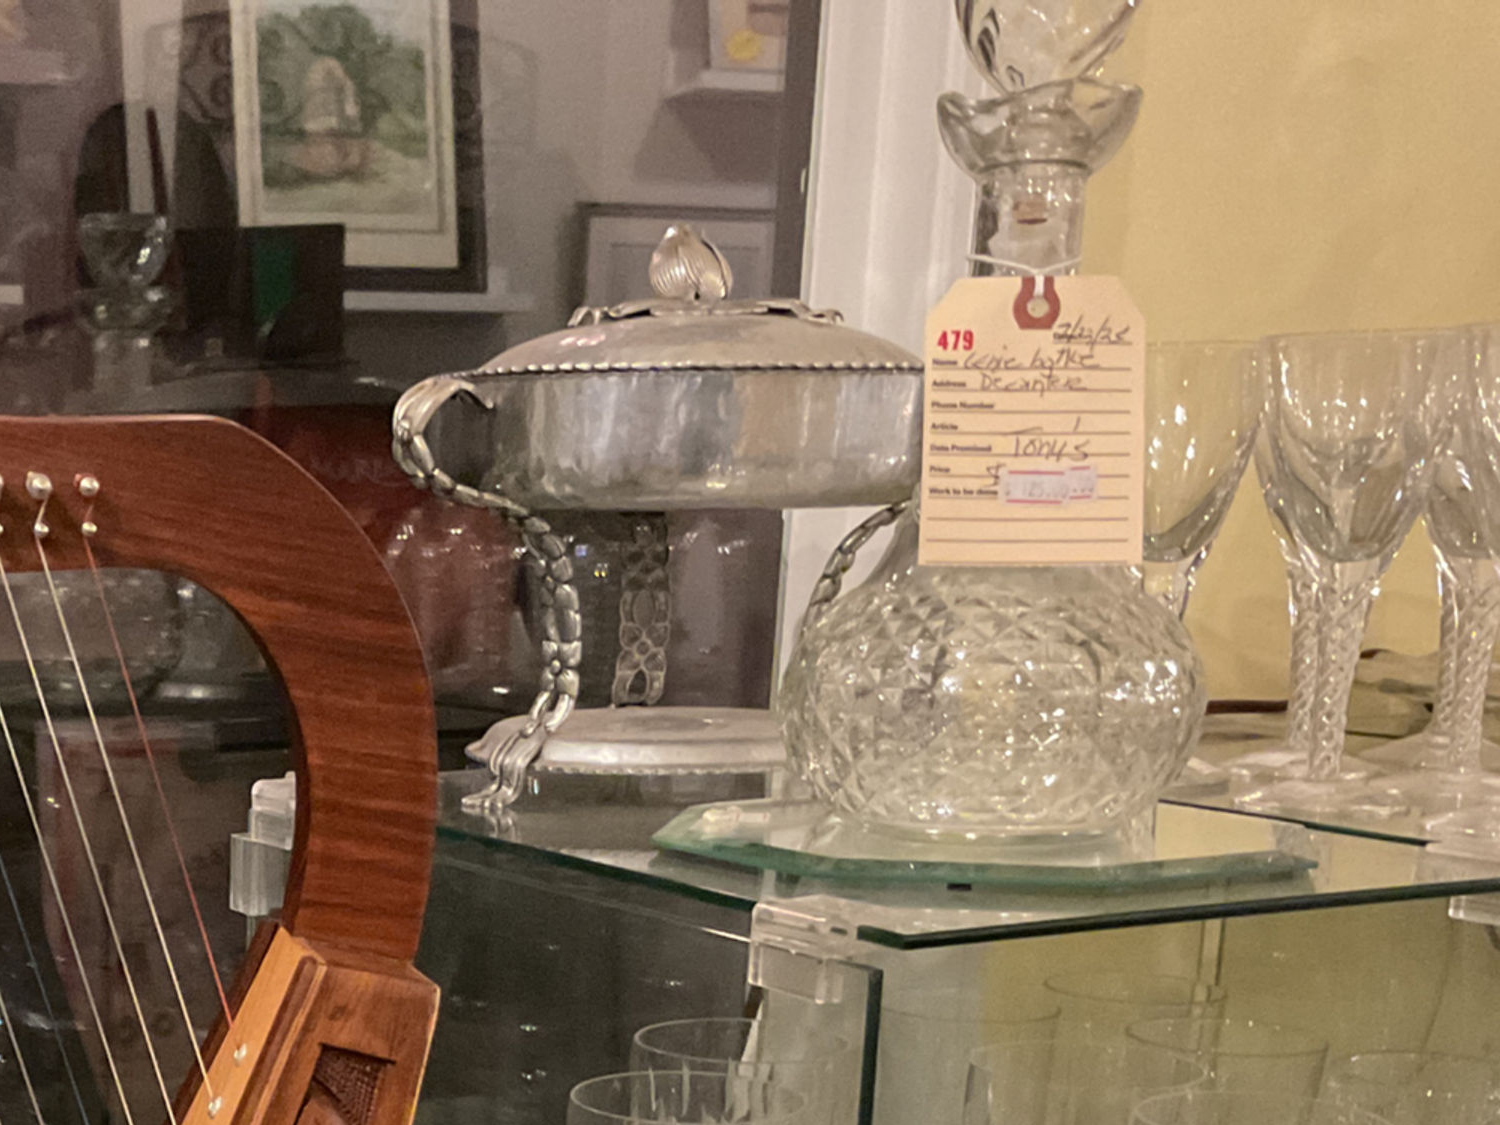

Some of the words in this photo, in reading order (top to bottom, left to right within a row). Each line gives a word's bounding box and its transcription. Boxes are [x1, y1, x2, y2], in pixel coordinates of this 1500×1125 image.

[937, 330, 974, 351] 479
[932, 358, 958, 366] Name
[932, 379, 966, 388] Address
[931, 401, 957, 409] Phone
[959, 401, 995, 409] Number
[929, 487, 950, 495] Work
